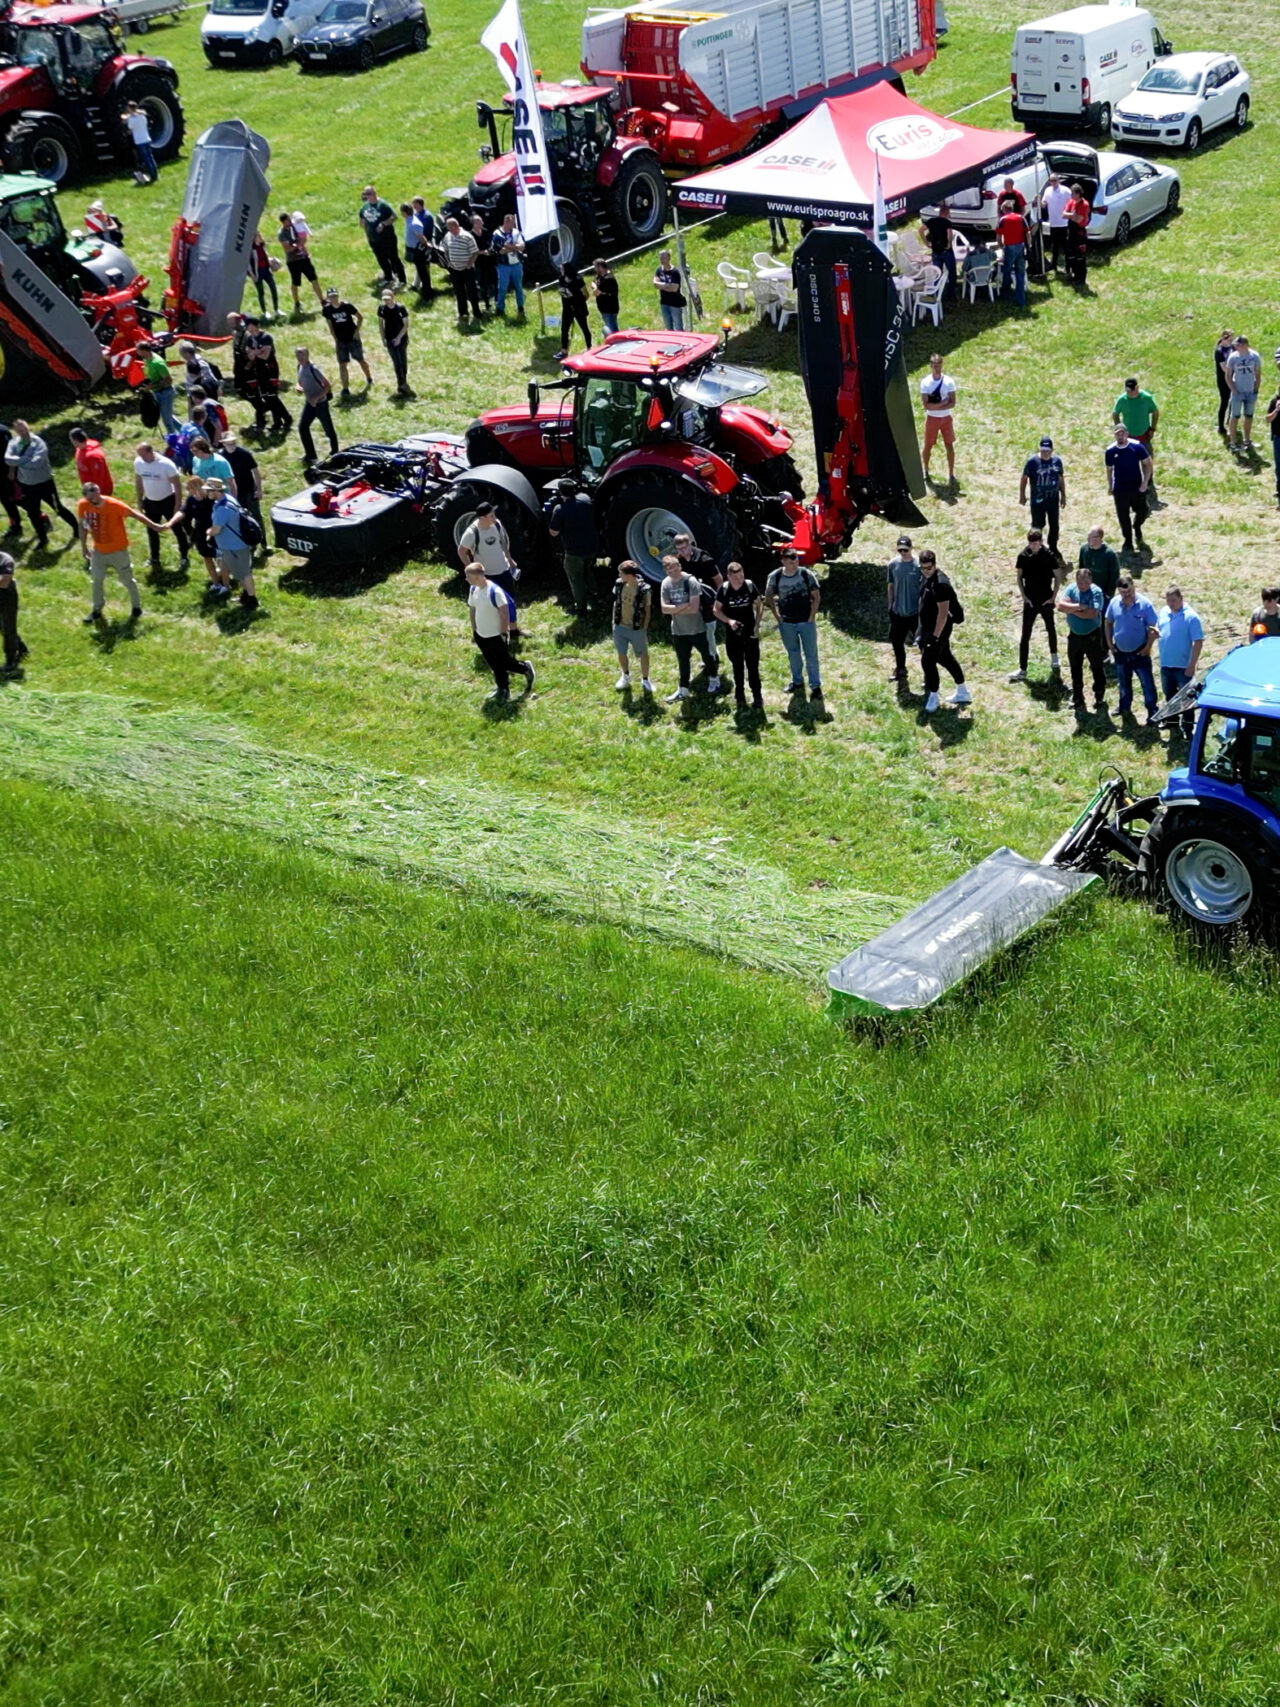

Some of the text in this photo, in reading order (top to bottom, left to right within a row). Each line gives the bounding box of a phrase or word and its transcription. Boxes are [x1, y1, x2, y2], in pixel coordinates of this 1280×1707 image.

[875, 123, 933, 151] Euris
[762, 154, 819, 168] CASE
[678, 190, 715, 203] CASE
[766, 201, 869, 222] www.eurisproagro.sk
[235, 203, 251, 253] KUHN
[12, 267, 56, 314] KUHN
[809, 273, 818, 296] DISC
[286, 536, 314, 554] SIP
